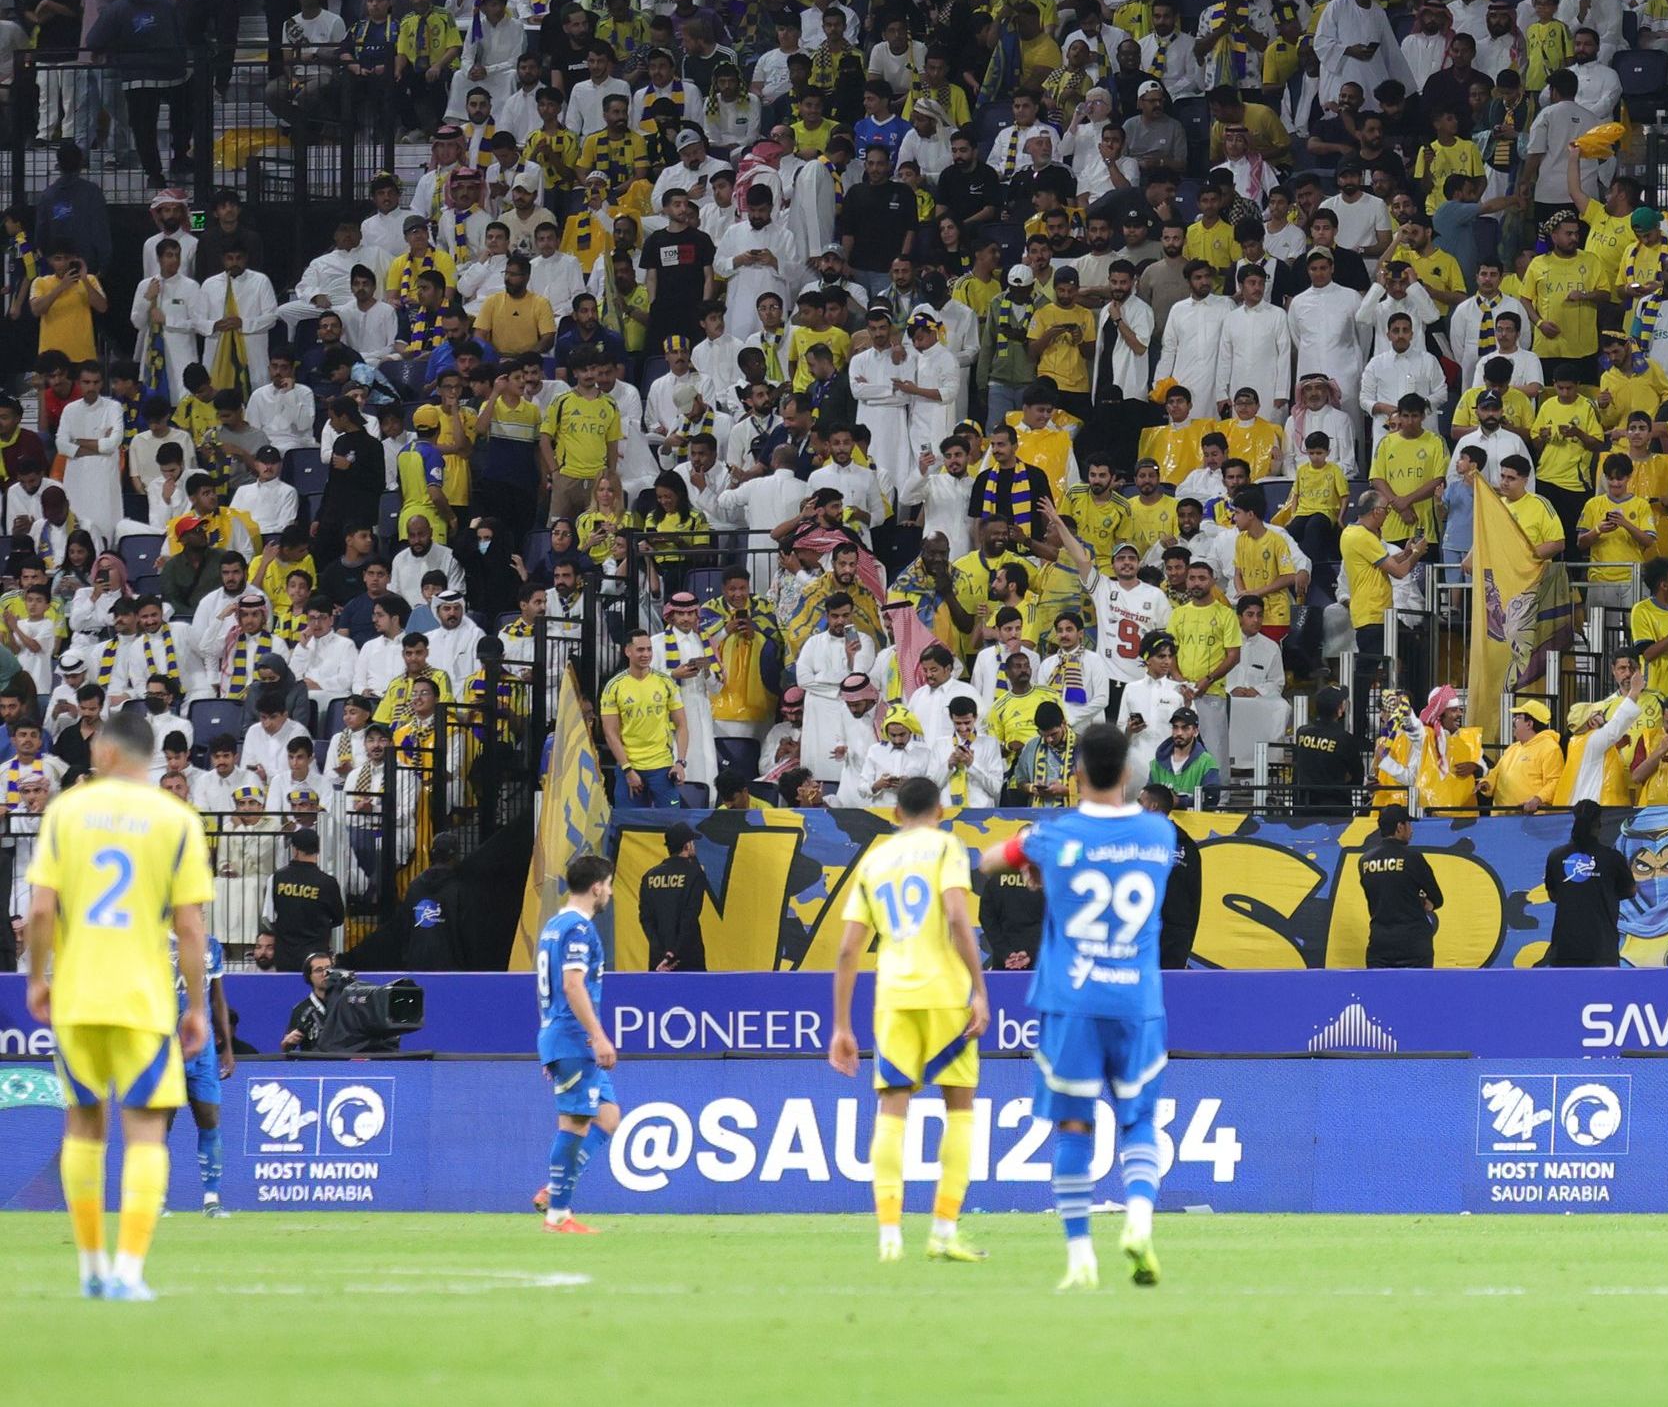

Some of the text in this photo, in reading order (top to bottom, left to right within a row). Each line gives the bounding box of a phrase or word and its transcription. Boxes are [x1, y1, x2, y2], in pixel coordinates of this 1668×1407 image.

[1591, 232, 1616, 246] KAFD
[568, 422, 605, 434] KAFD
[1389, 467, 1424, 479] KAFD
[1298, 740, 1336, 754] POLICE
[1363, 857, 1404, 873] POLICE
[86, 846, 134, 927] 2
[648, 874, 685, 889] POLICE
[1000, 873, 1030, 886] POLI
[278, 883, 319, 899] POLICE
[876, 874, 932, 938] 19
[1066, 870, 1156, 940] 29
[616, 1005, 823, 1050] PIONEER
[608, 1097, 1243, 1193] @SAUDI24
[255, 1162, 379, 1181] HOST NATION
[1487, 1162, 1615, 1180] HOST NATION
[258, 1184, 374, 1203] SAUDI ARABIA
[1491, 1185, 1610, 1203] SAUDI ARABIA
